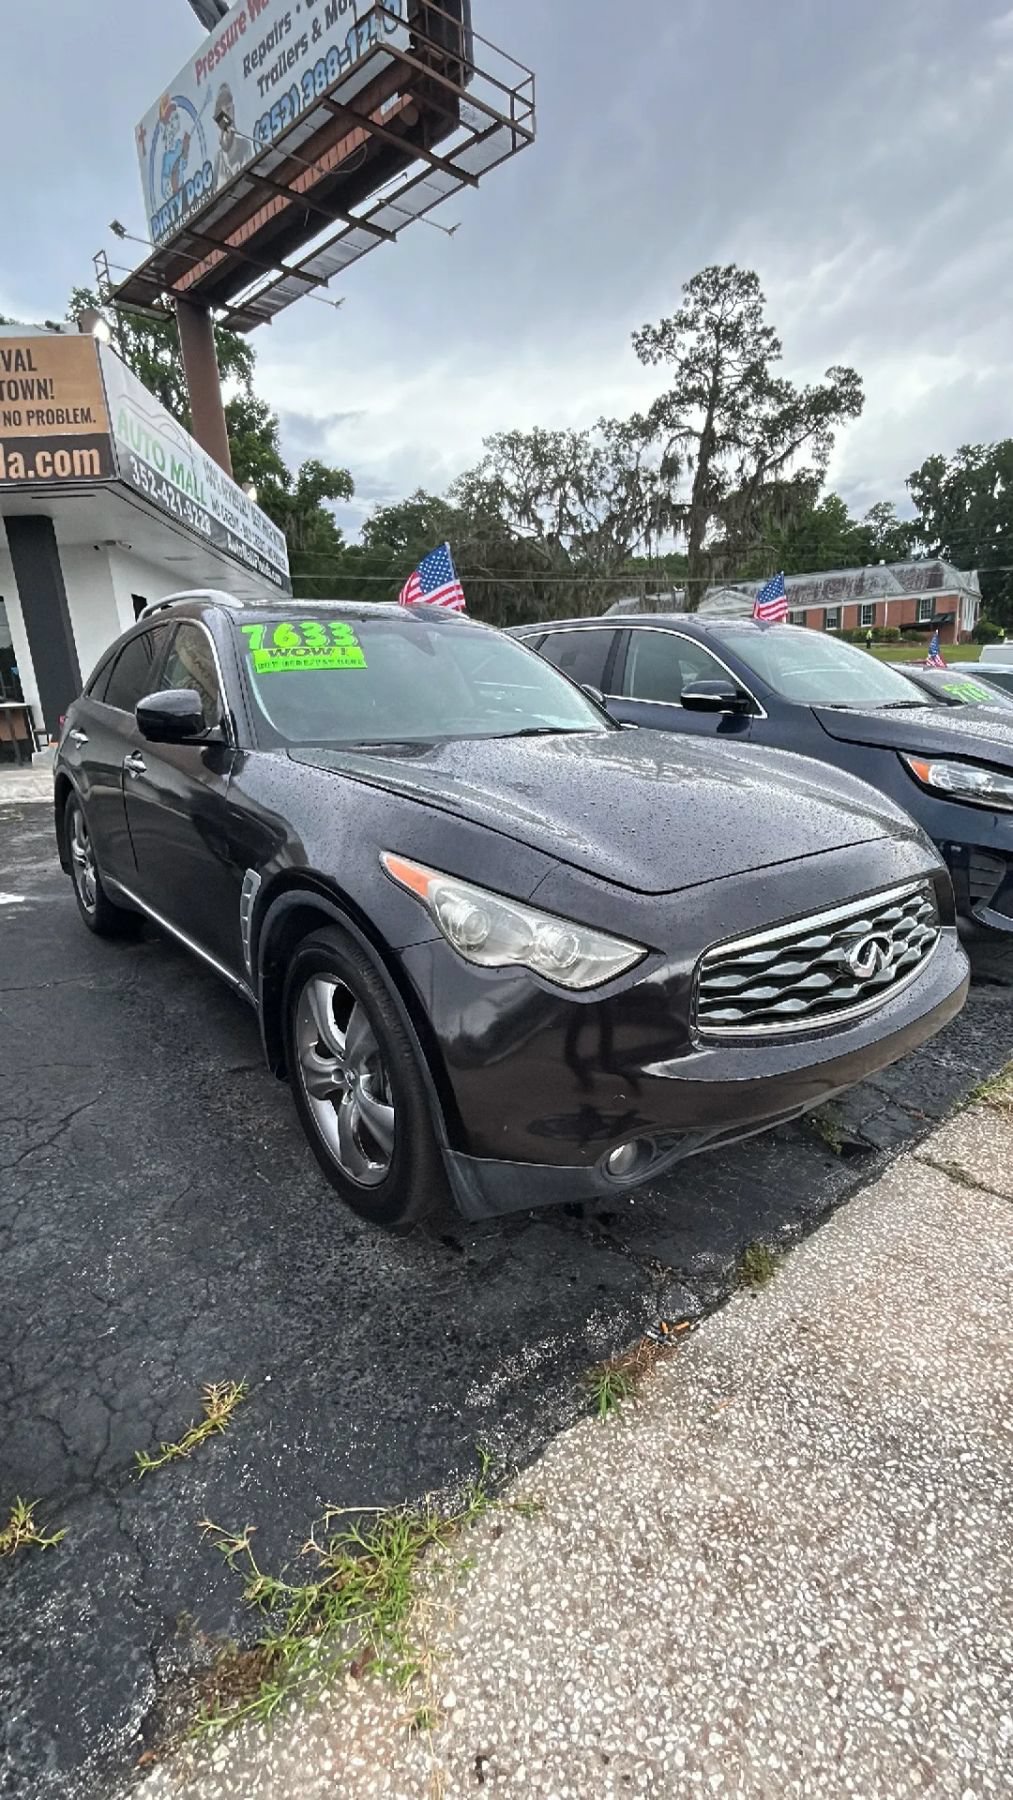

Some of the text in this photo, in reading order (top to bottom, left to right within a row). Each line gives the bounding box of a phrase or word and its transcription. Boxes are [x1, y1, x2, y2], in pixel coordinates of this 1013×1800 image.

[195, 10, 247, 86] Pressure
[243, 11, 292, 78] Repairs
[256, 32, 309, 98] Trailers
[312, 17, 323, 44] &
[253, 82, 300, 154] (352)
[151, 160, 214, 241] DIRTY DOG
[191, 189, 212, 215] SUPPLY
[3, 407, 96, 427] NO PROBLEM.
[117, 407, 208, 507] AUTO MALL
[240, 620, 359, 650] 7633
[268, 648, 334, 658] WOW
